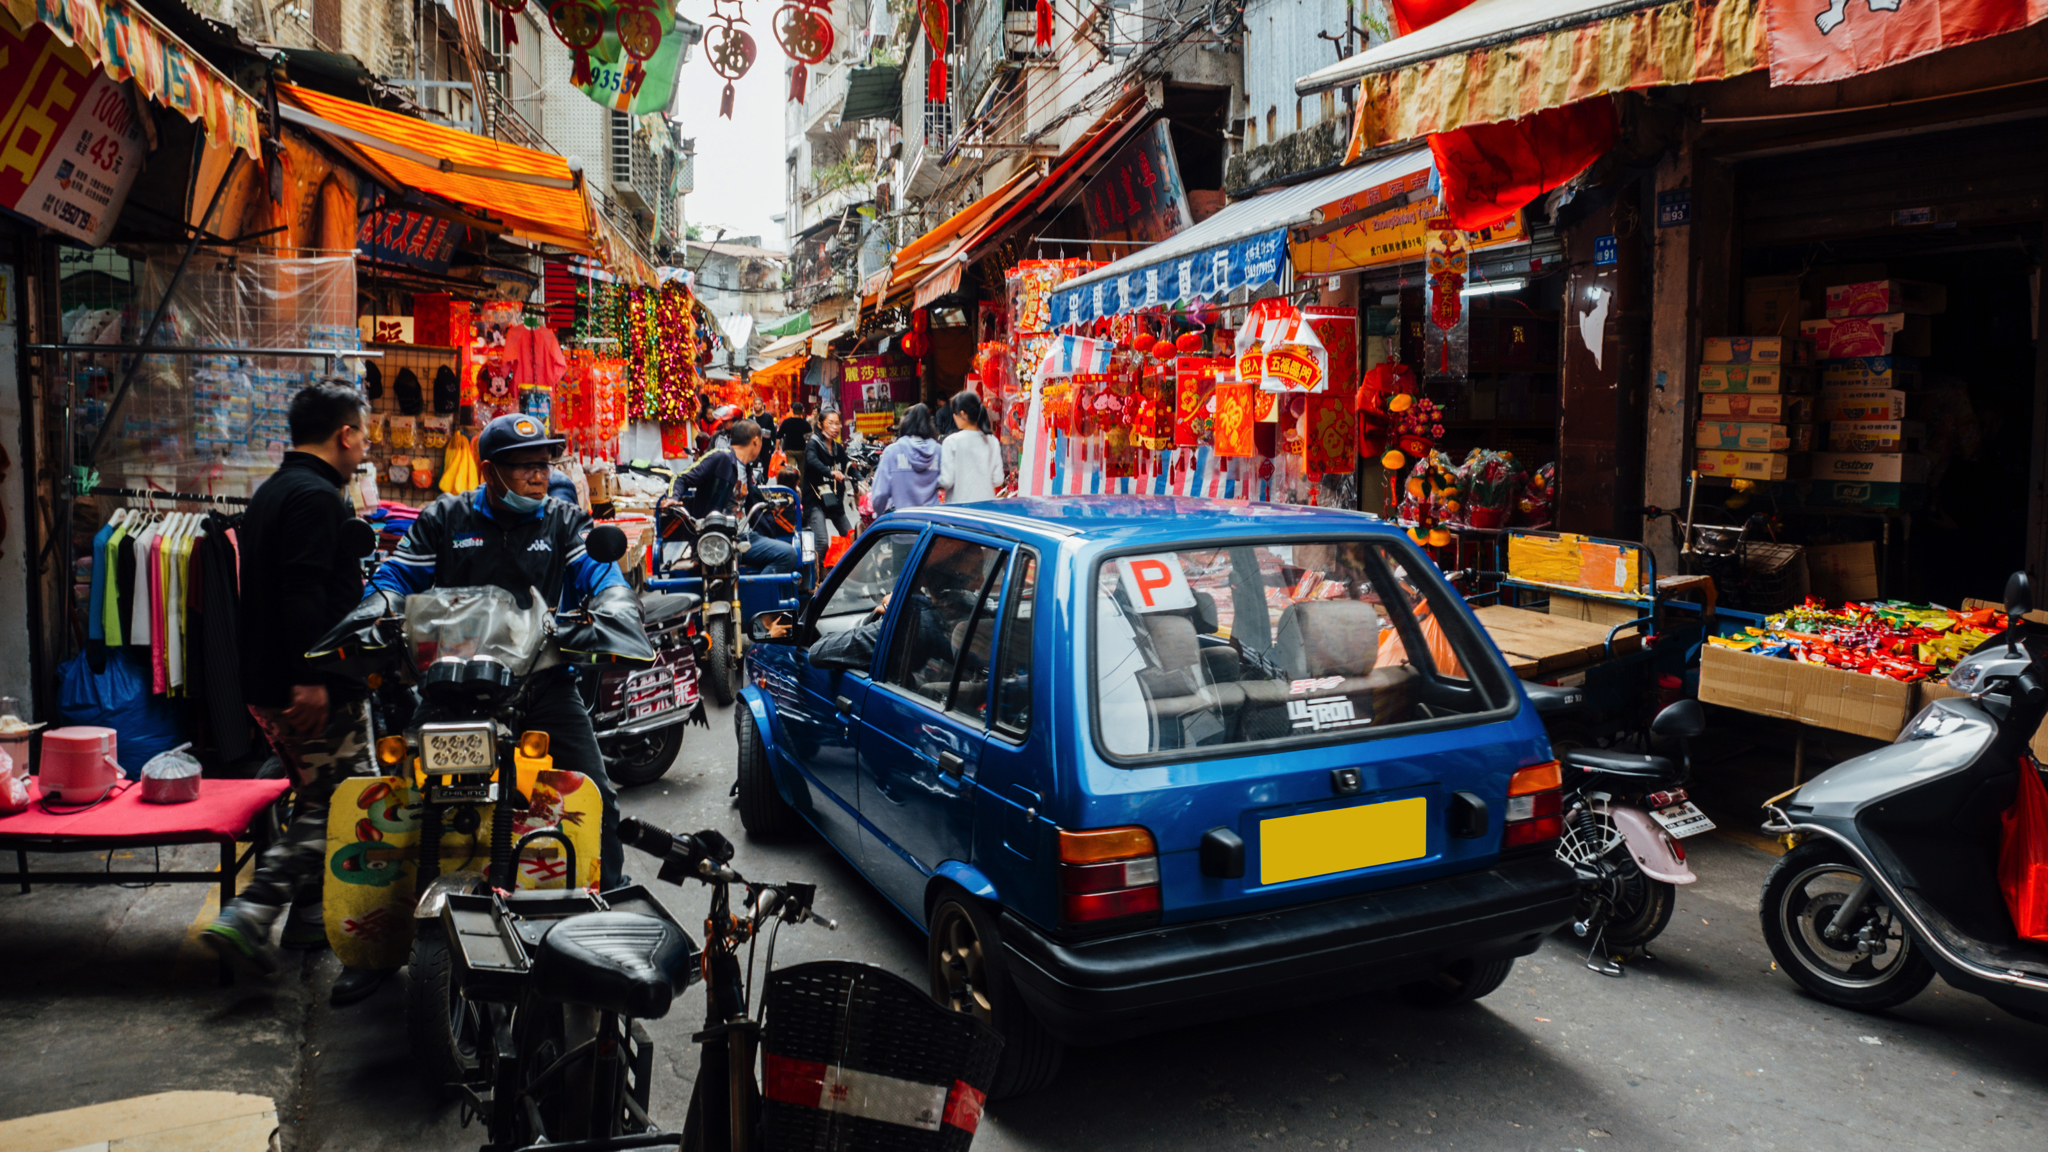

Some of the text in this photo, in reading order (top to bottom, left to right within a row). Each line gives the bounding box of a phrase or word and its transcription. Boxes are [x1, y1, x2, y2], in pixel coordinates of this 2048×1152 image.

[1671, 210, 1684, 221] 93
[1603, 248, 1615, 261] 91
[1270, 355, 1314, 385] 五福臨門
[1130, 558, 1173, 608] P
